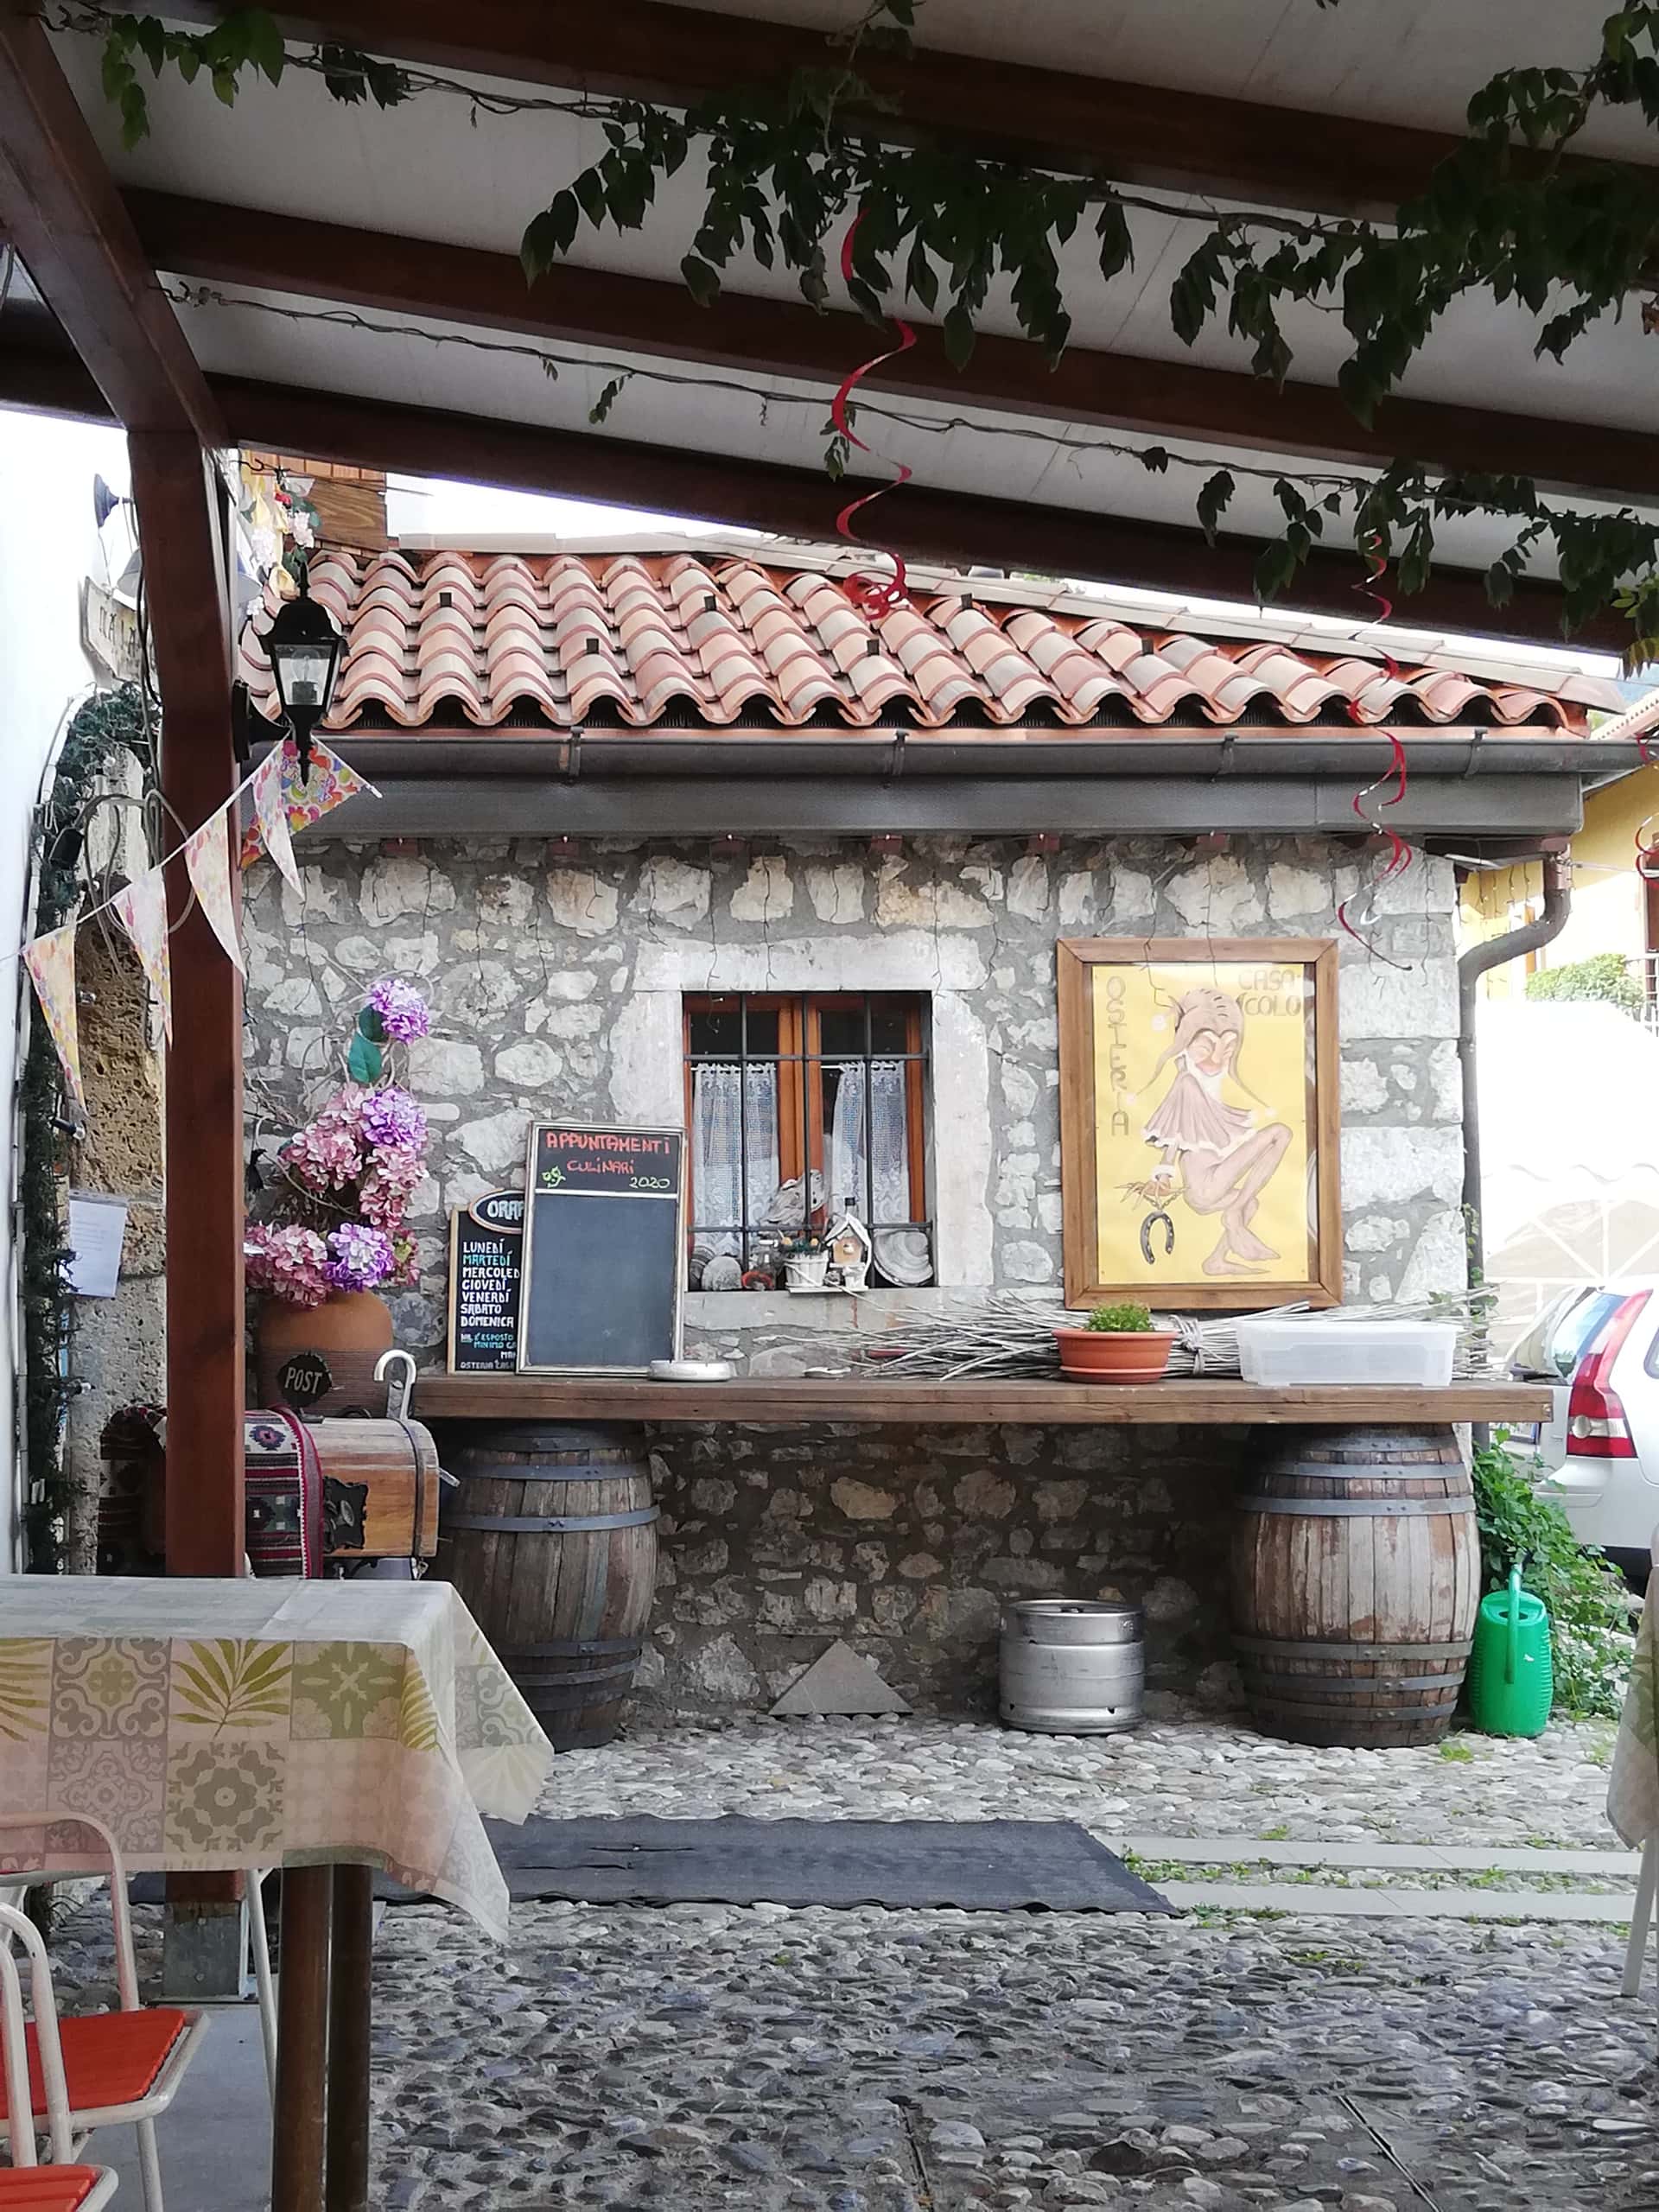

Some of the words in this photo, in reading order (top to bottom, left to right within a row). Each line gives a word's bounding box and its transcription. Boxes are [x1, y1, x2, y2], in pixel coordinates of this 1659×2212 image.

[1106, 976, 1129, 1136] OSTERIA
[629, 1176, 671, 1189] 2020
[460, 1303, 502, 1315] SABATO
[460, 1316, 515, 1328] DOMENICA
[283, 1366, 323, 1395] POST
